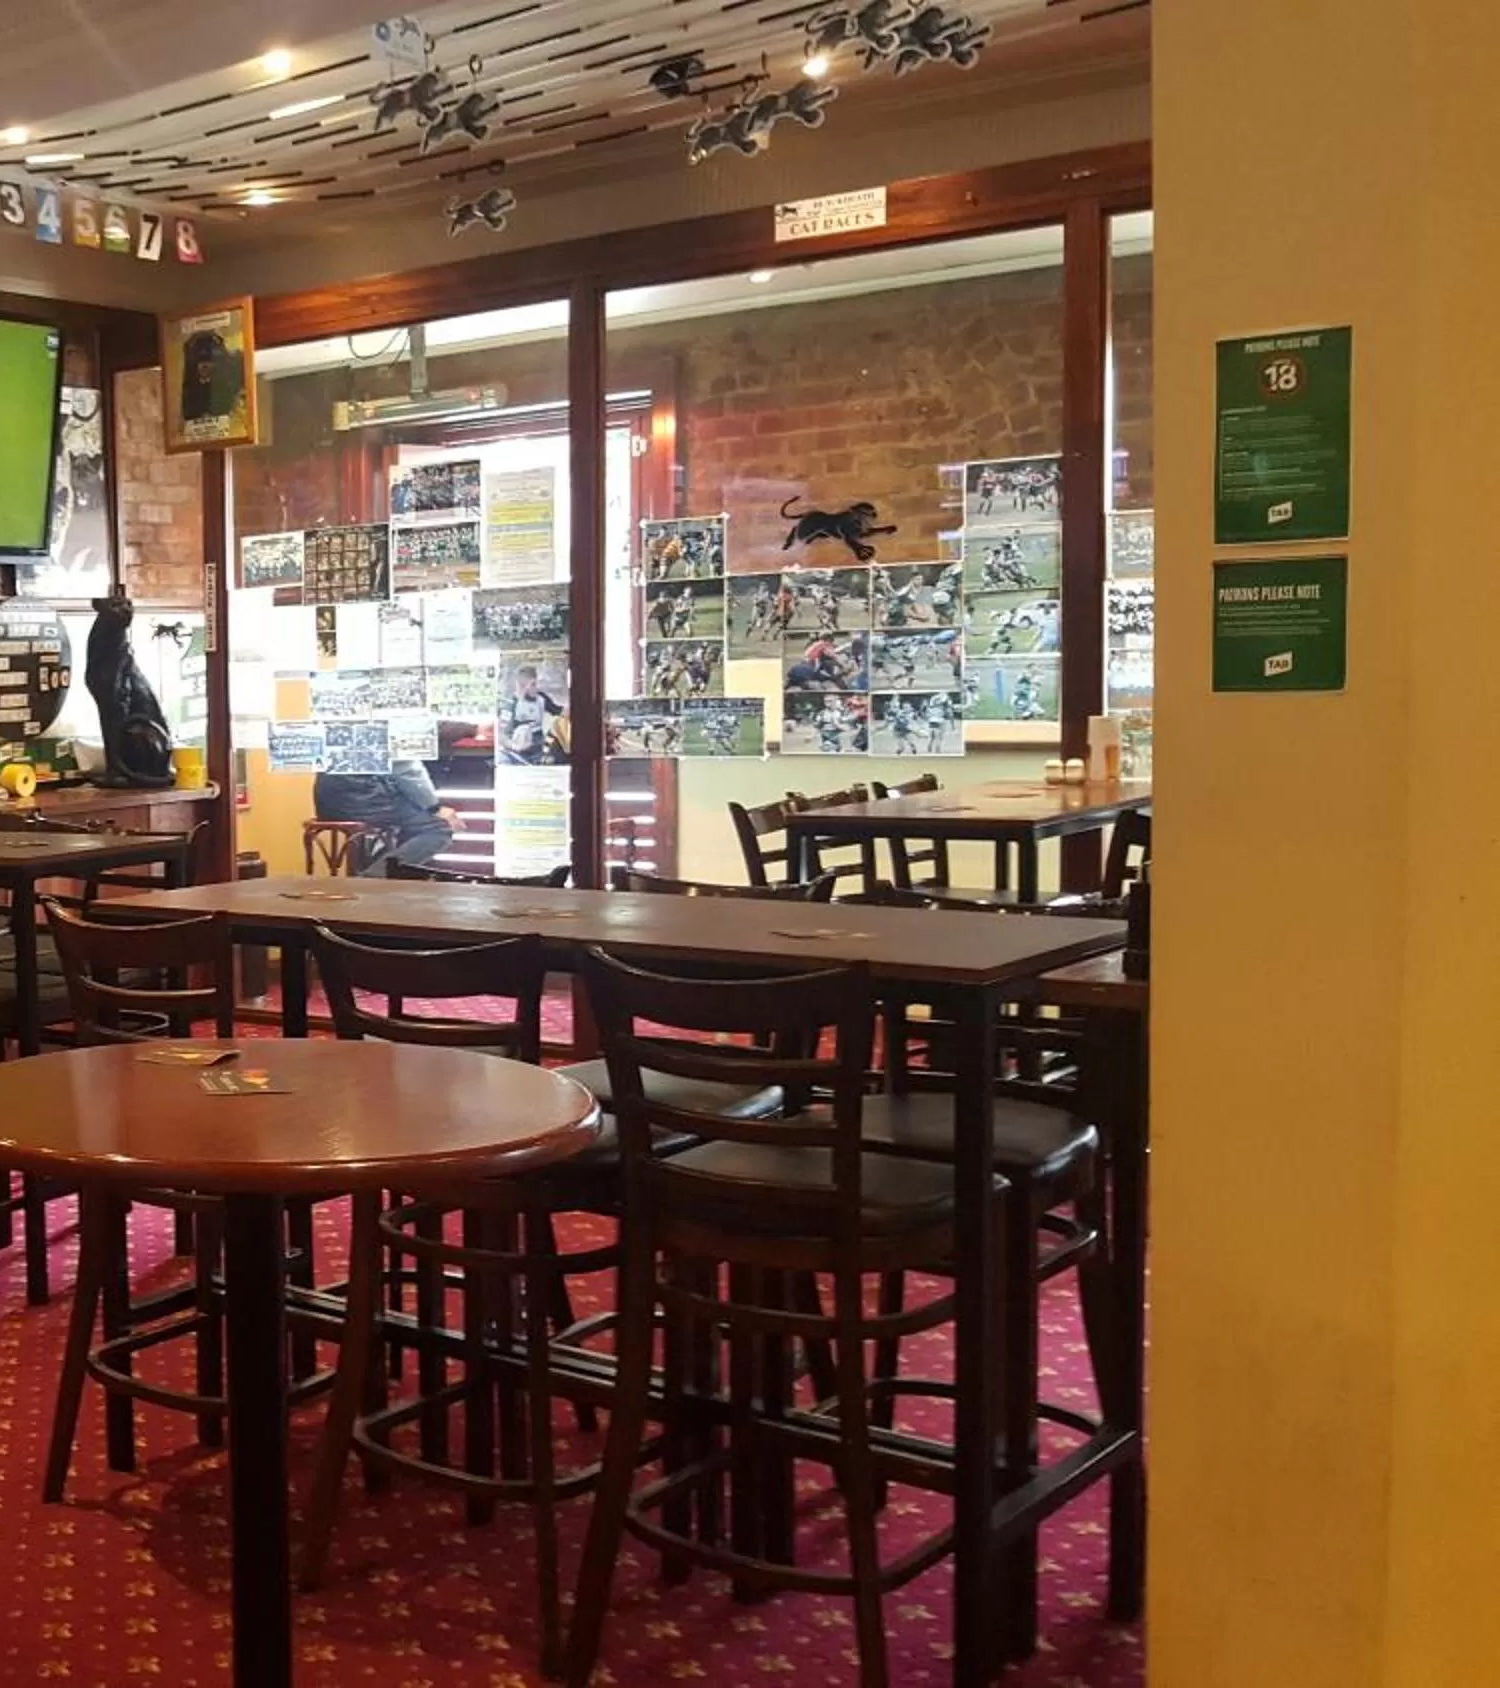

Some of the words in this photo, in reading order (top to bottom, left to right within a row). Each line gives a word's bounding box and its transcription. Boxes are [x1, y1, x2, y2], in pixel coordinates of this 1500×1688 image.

[0, 183, 24, 225] 3
[37, 191, 61, 230] 4
[74, 199, 97, 237] 5
[105, 206, 128, 240] 6
[141, 214, 161, 251] 7
[177, 220, 199, 256] 8
[789, 219, 818, 236] CAT
[823, 211, 875, 231] RACES
[1263, 363, 1298, 392] 18
[1219, 587, 1260, 603] PATRONS
[1261, 585, 1294, 601] PLEASE
[1296, 583, 1321, 600] NOTE
